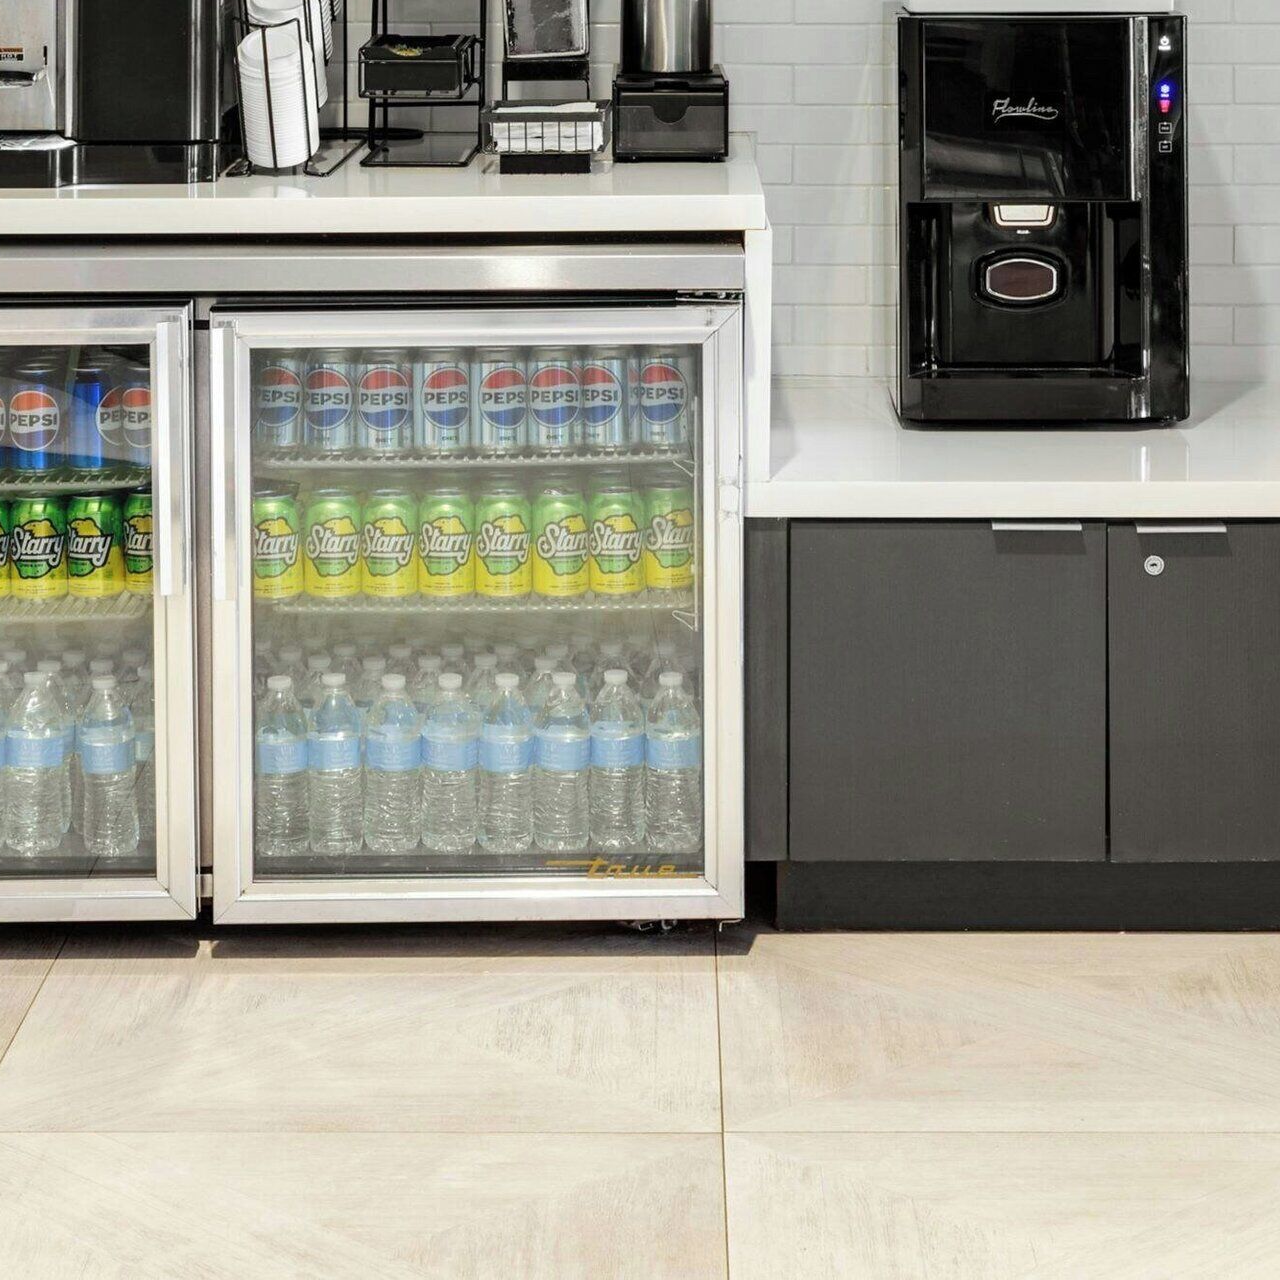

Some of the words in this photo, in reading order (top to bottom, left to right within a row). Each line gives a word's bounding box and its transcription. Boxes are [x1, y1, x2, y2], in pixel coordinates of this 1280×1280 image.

[992, 97, 1058, 123] Flowline
[361, 392, 407, 405] PEPSI
[424, 391, 467, 404] PEPS
[482, 391, 525, 404] PEPS
[531, 390, 579, 403] PEPSI
[10, 413, 57, 426] PEPSI
[10, 526, 64, 567] Starry
[68, 524, 112, 567] tarry
[306, 524, 360, 564] Starry
[362, 523, 415, 566] Starry
[420, 522, 472, 565] Starry
[477, 522, 531, 563] Starry
[588, 521, 642, 562] Starry
